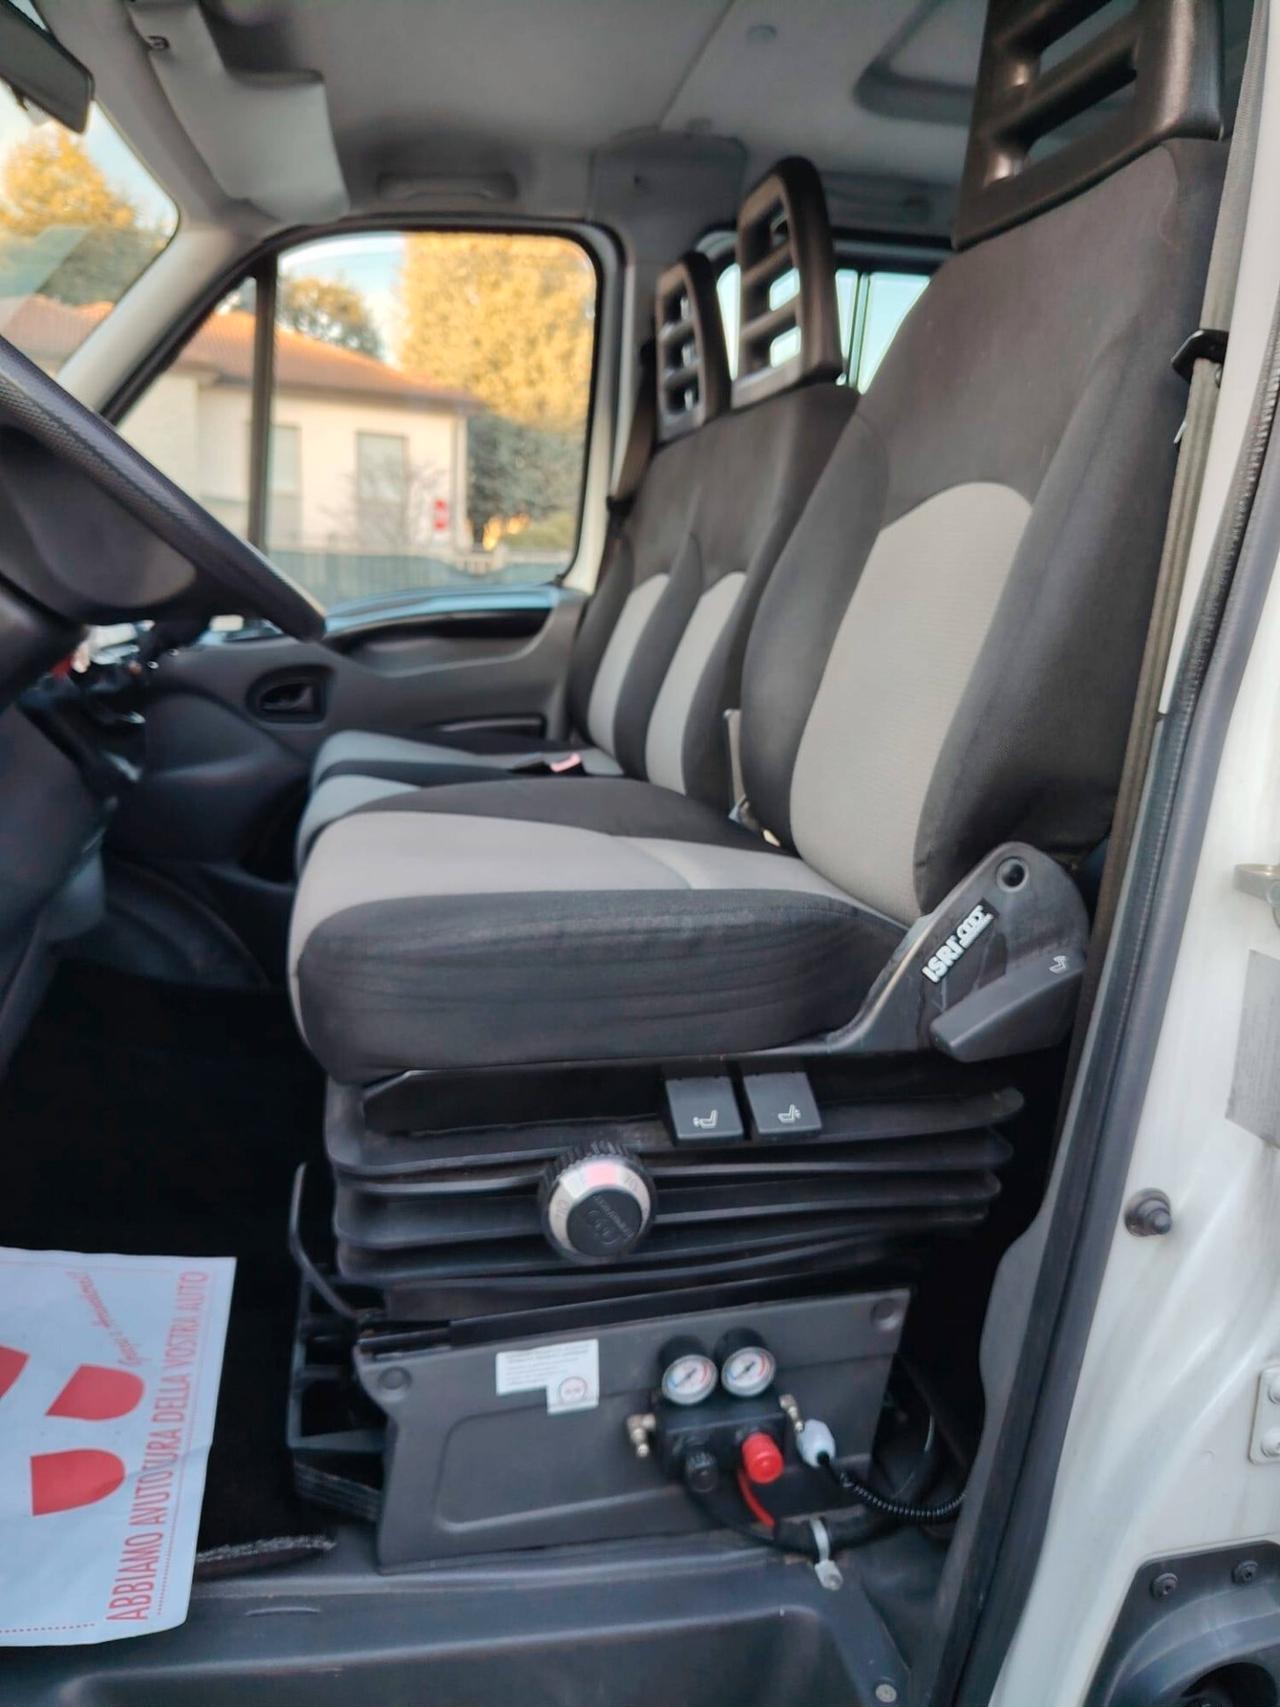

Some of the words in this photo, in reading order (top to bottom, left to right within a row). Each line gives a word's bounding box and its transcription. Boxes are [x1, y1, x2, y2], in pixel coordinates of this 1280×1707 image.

[176, 1271, 208, 1310] AUTO
[163, 1315, 200, 1369] VOSTRA
[152, 1373, 190, 1422] DELLA
[129, 1471, 172, 1525] AVUTO
[105, 1531, 164, 1620] ABBIAMO
